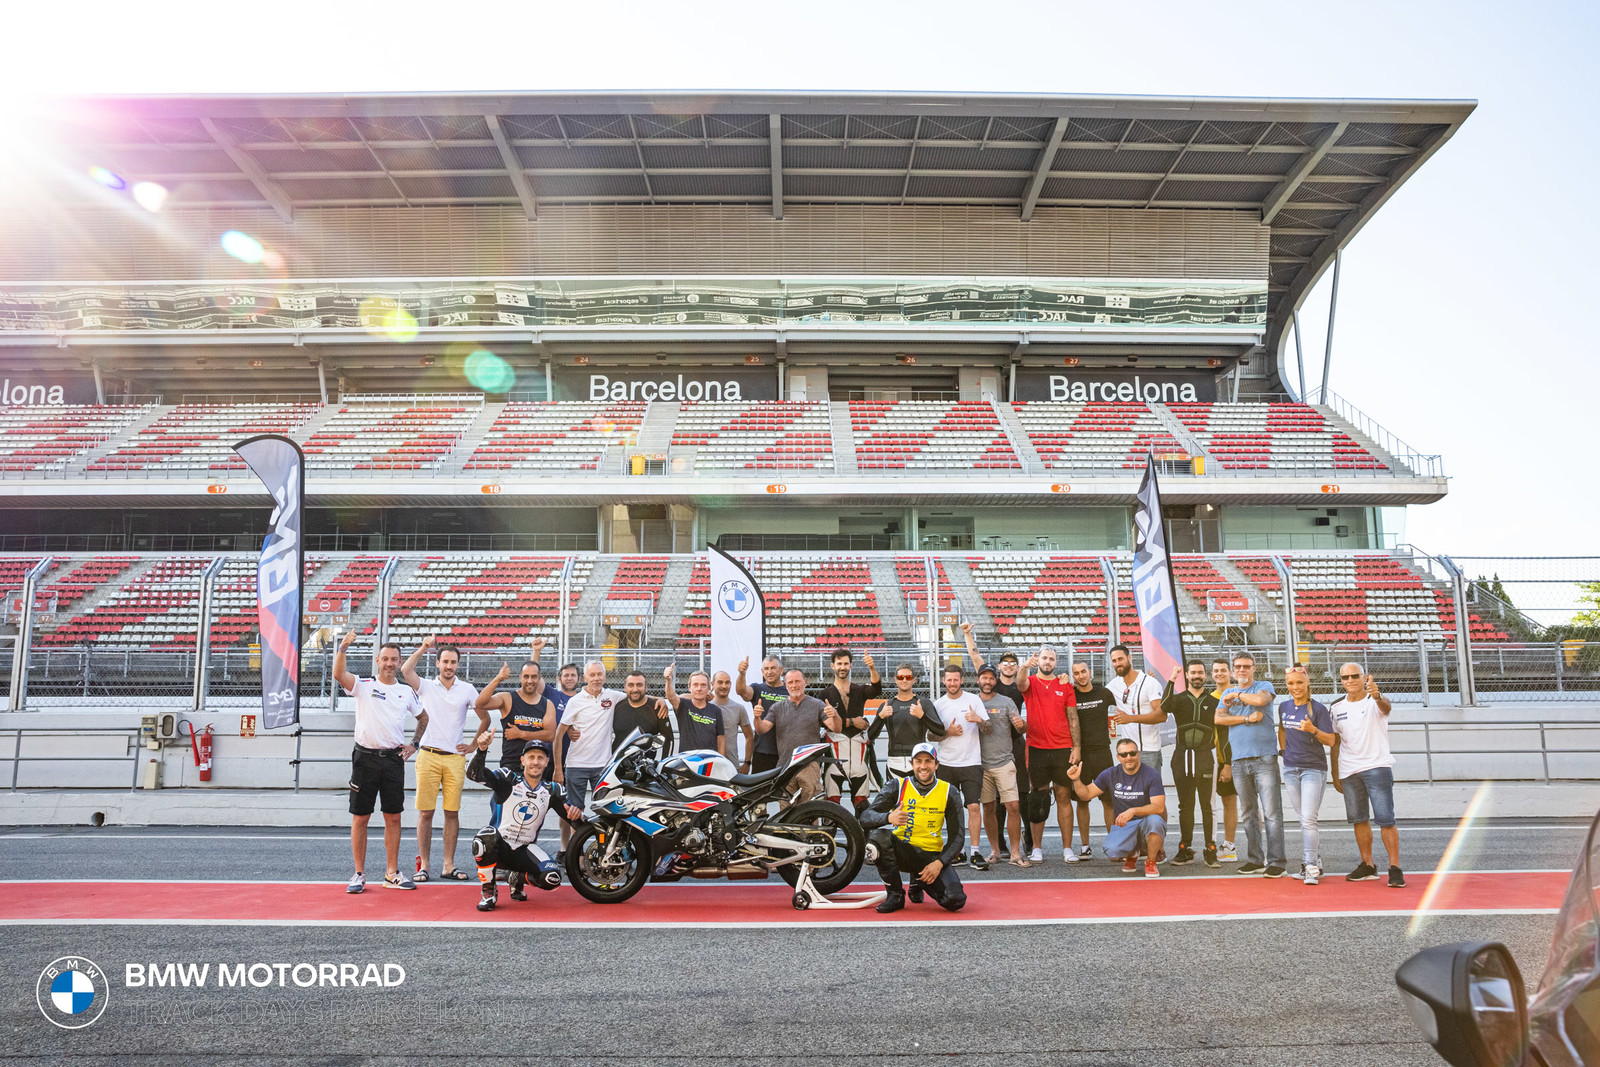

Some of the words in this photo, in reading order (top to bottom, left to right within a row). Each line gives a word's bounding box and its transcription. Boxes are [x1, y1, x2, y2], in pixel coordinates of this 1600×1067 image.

[750, 355, 760, 363] 25
[0, 379, 64, 405] lona
[589, 374, 742, 402] Barcelona
[1049, 375, 1198, 403] Barcelona
[215, 485, 227, 493] 17
[488, 485, 500, 493] 18
[774, 484, 786, 493] 19
[1058, 484, 1070, 493] 20
[1327, 485, 1339, 493] 21
